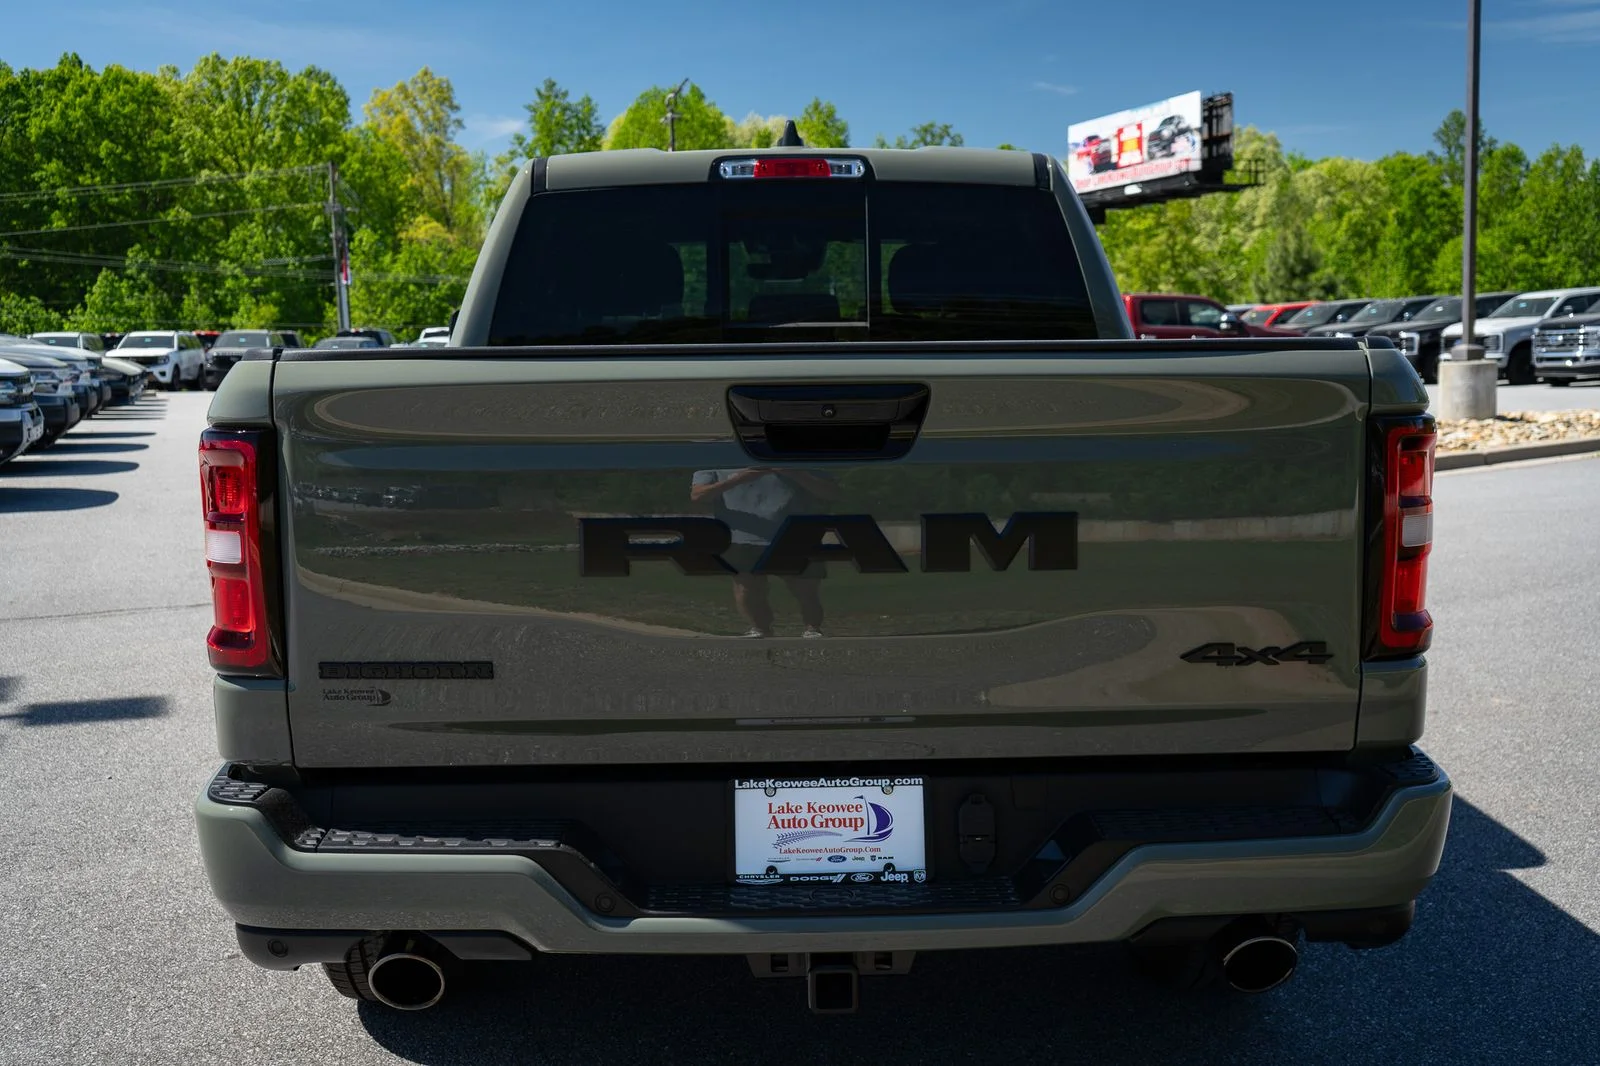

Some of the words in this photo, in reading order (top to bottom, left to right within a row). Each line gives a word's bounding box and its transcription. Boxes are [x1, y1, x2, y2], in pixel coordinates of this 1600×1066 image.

[580, 512, 1078, 577] RAM
[346, 694, 376, 702] Group
[735, 777, 923, 789] LakeKeoweeAutoGroup.com
[768, 802, 803, 814] Lake
[807, 801, 863, 814] Keowee
[767, 815, 808, 830] Auto
[810, 814, 865, 831] Group
[779, 846, 881, 855] LakeKeoweeAutoGroup.Com
[880, 871, 909, 883] Jeep
